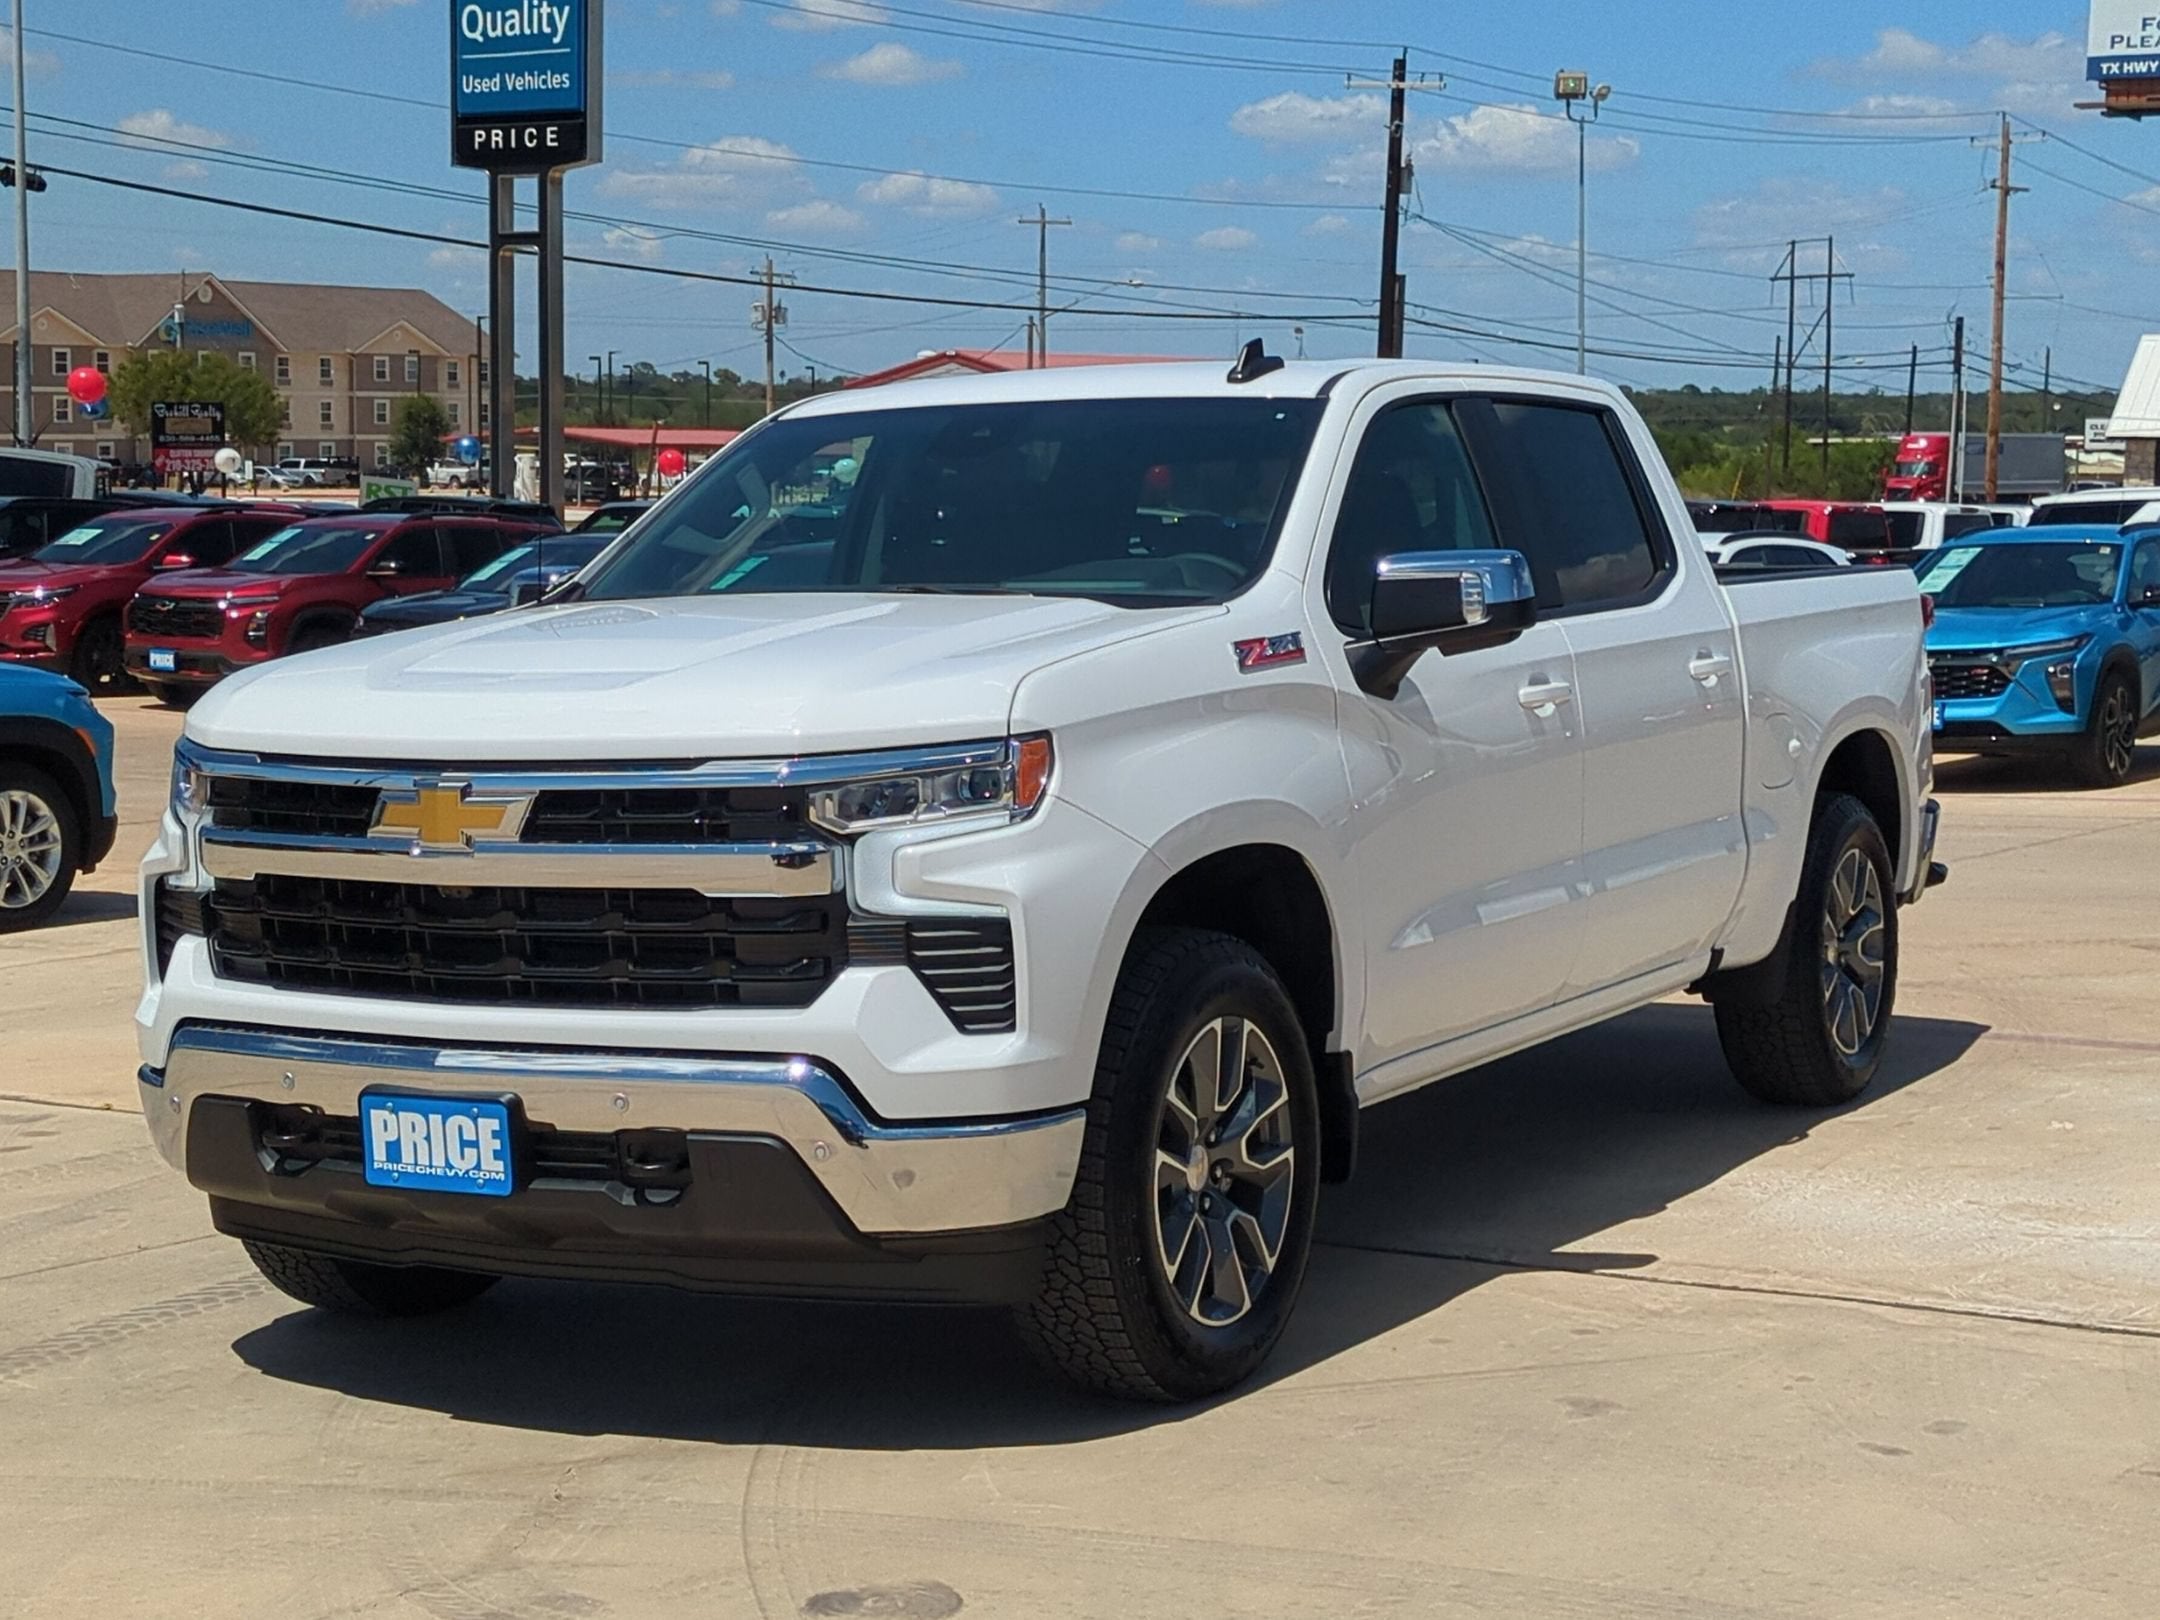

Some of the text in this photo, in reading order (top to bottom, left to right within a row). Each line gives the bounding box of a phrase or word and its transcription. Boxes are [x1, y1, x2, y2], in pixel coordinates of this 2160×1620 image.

[461, 0, 571, 44] Quality
[2101, 60, 2159, 75] TX HWY
[462, 70, 570, 94] Used Vehicles
[474, 126, 559, 150] PRICE
[370, 1108, 505, 1172] PRICE
[373, 1161, 505, 1181] PRICECHEVY.COM
